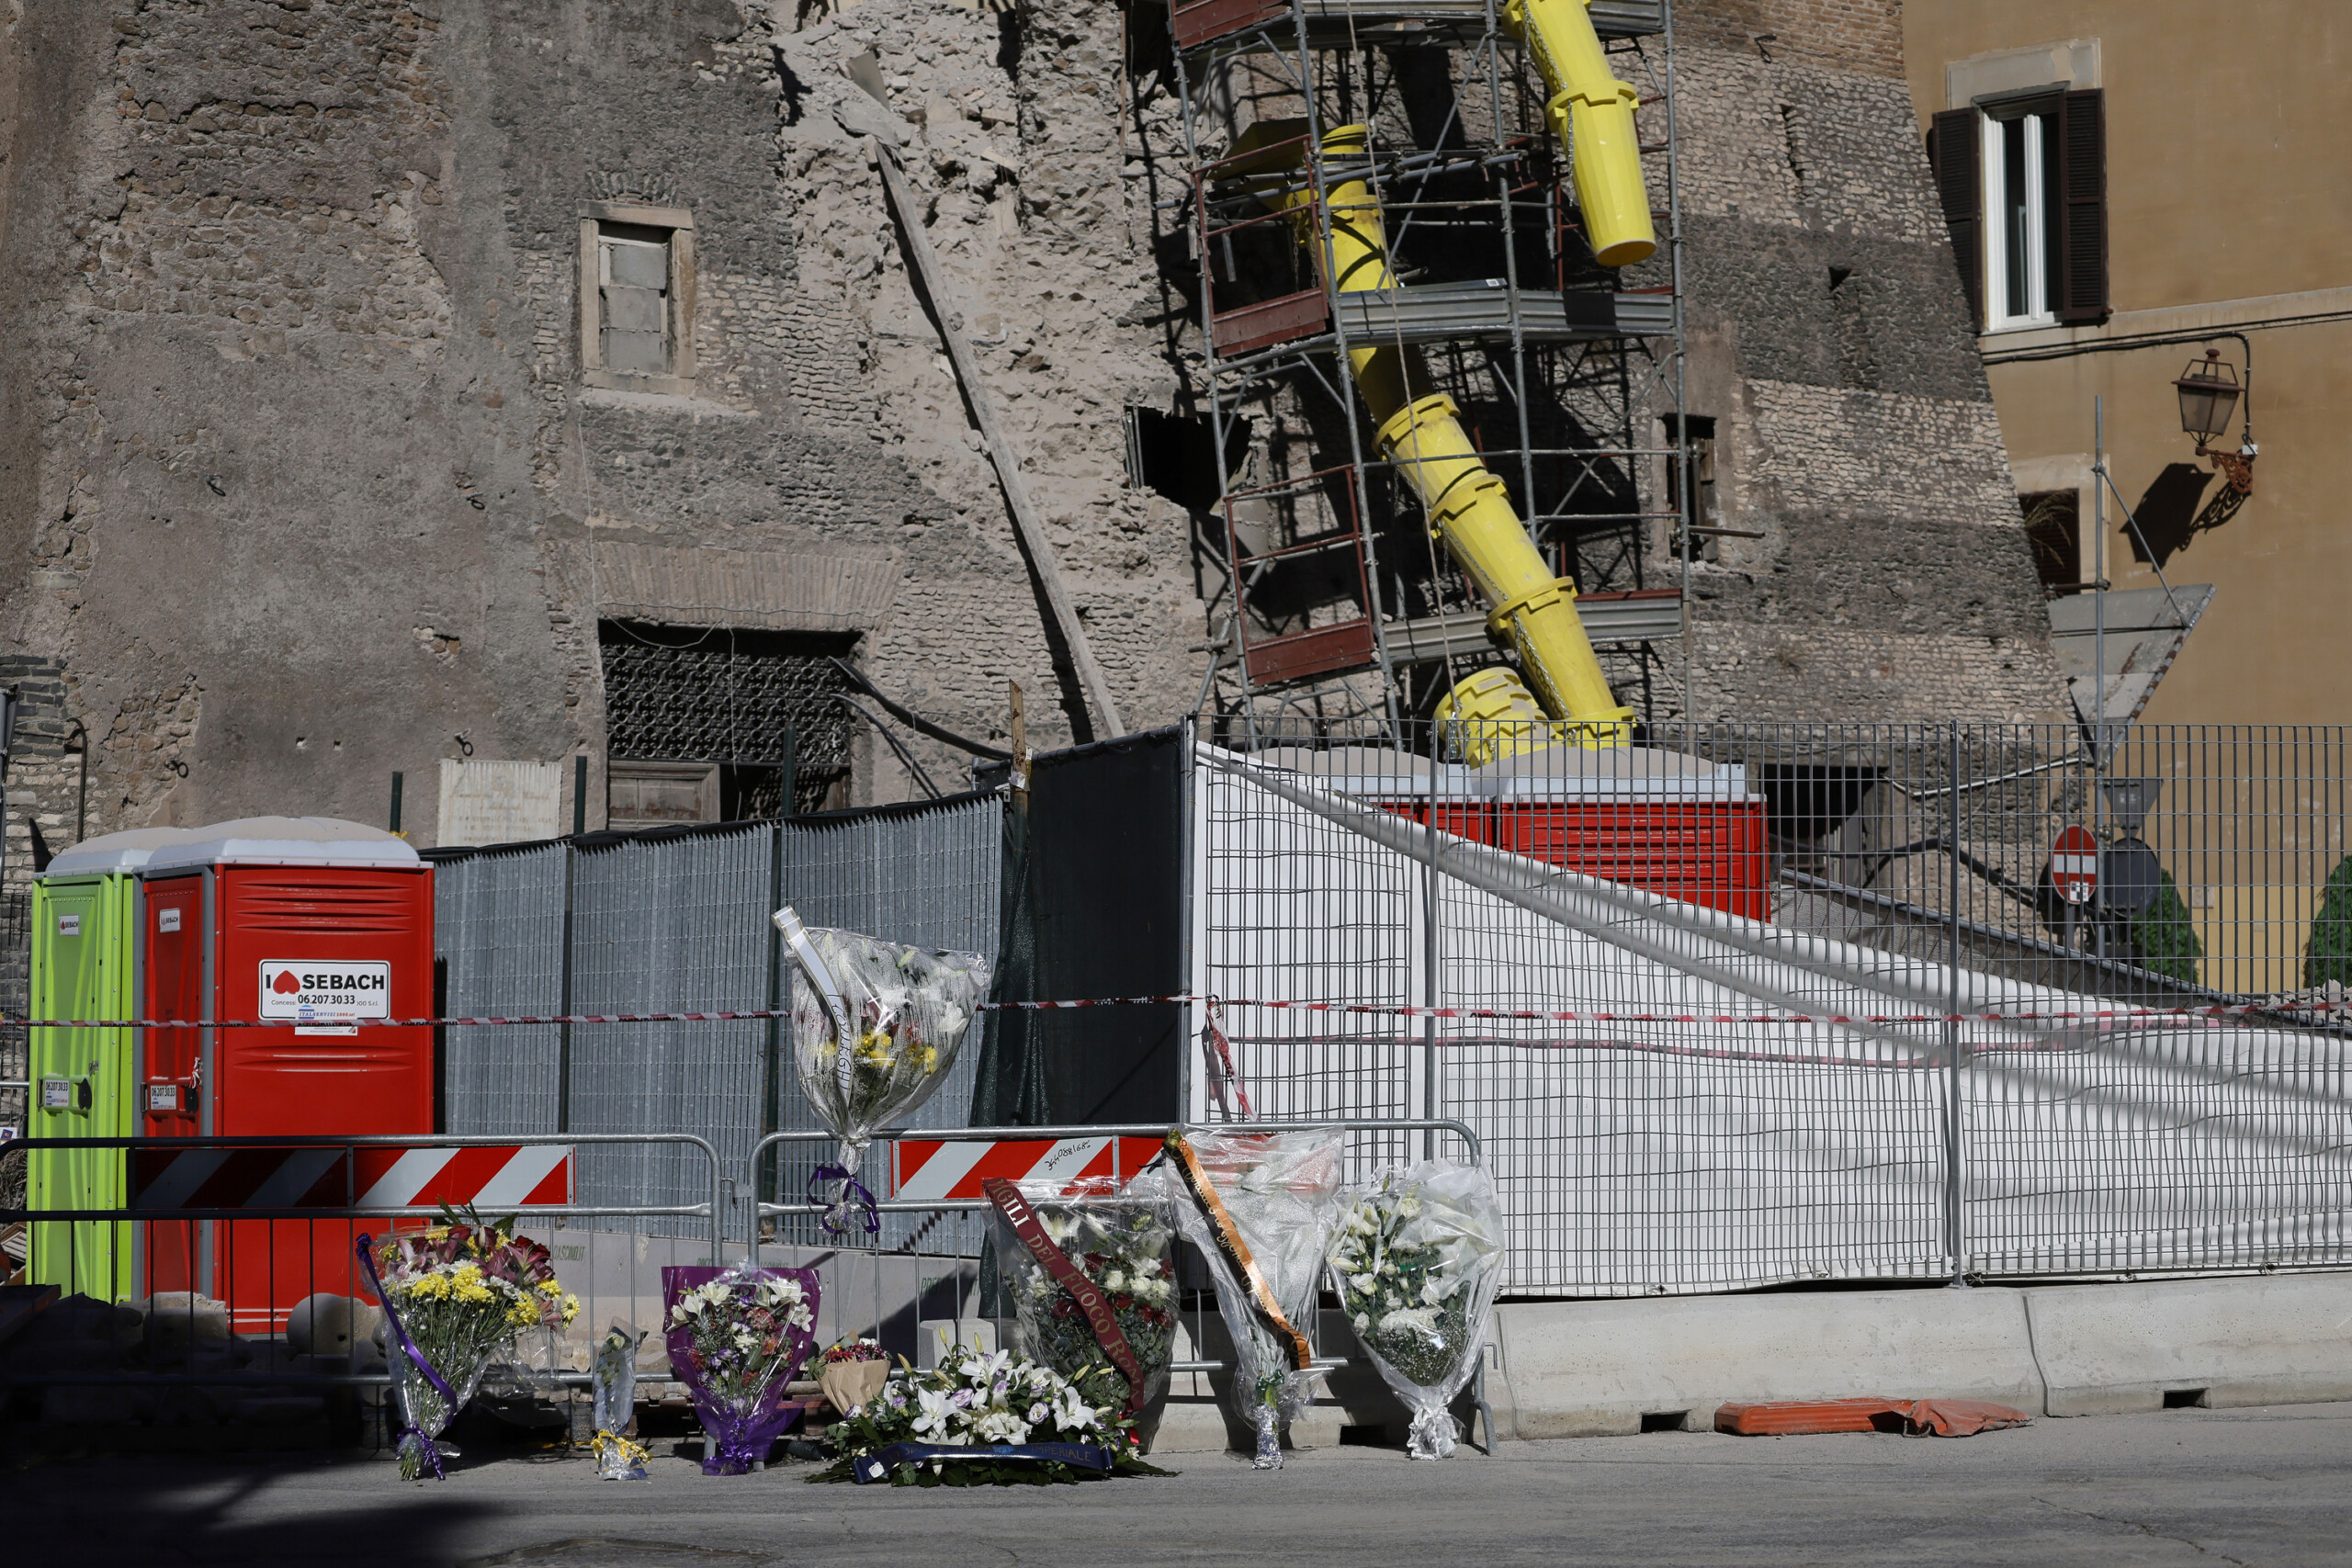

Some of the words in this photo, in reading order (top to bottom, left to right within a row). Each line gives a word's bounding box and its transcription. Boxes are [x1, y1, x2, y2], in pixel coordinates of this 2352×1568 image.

[266, 974, 271, 989] I
[301, 974, 385, 990] SEBACH
[298, 994, 356, 1005] 06.207.30.33
[831, 1003, 852, 1090] COLLEGHI
[1026, 1233, 1057, 1268] DEL
[1060, 1270, 1111, 1334] FUOCO
[1031, 1445, 1092, 1462] IMPERIALE
